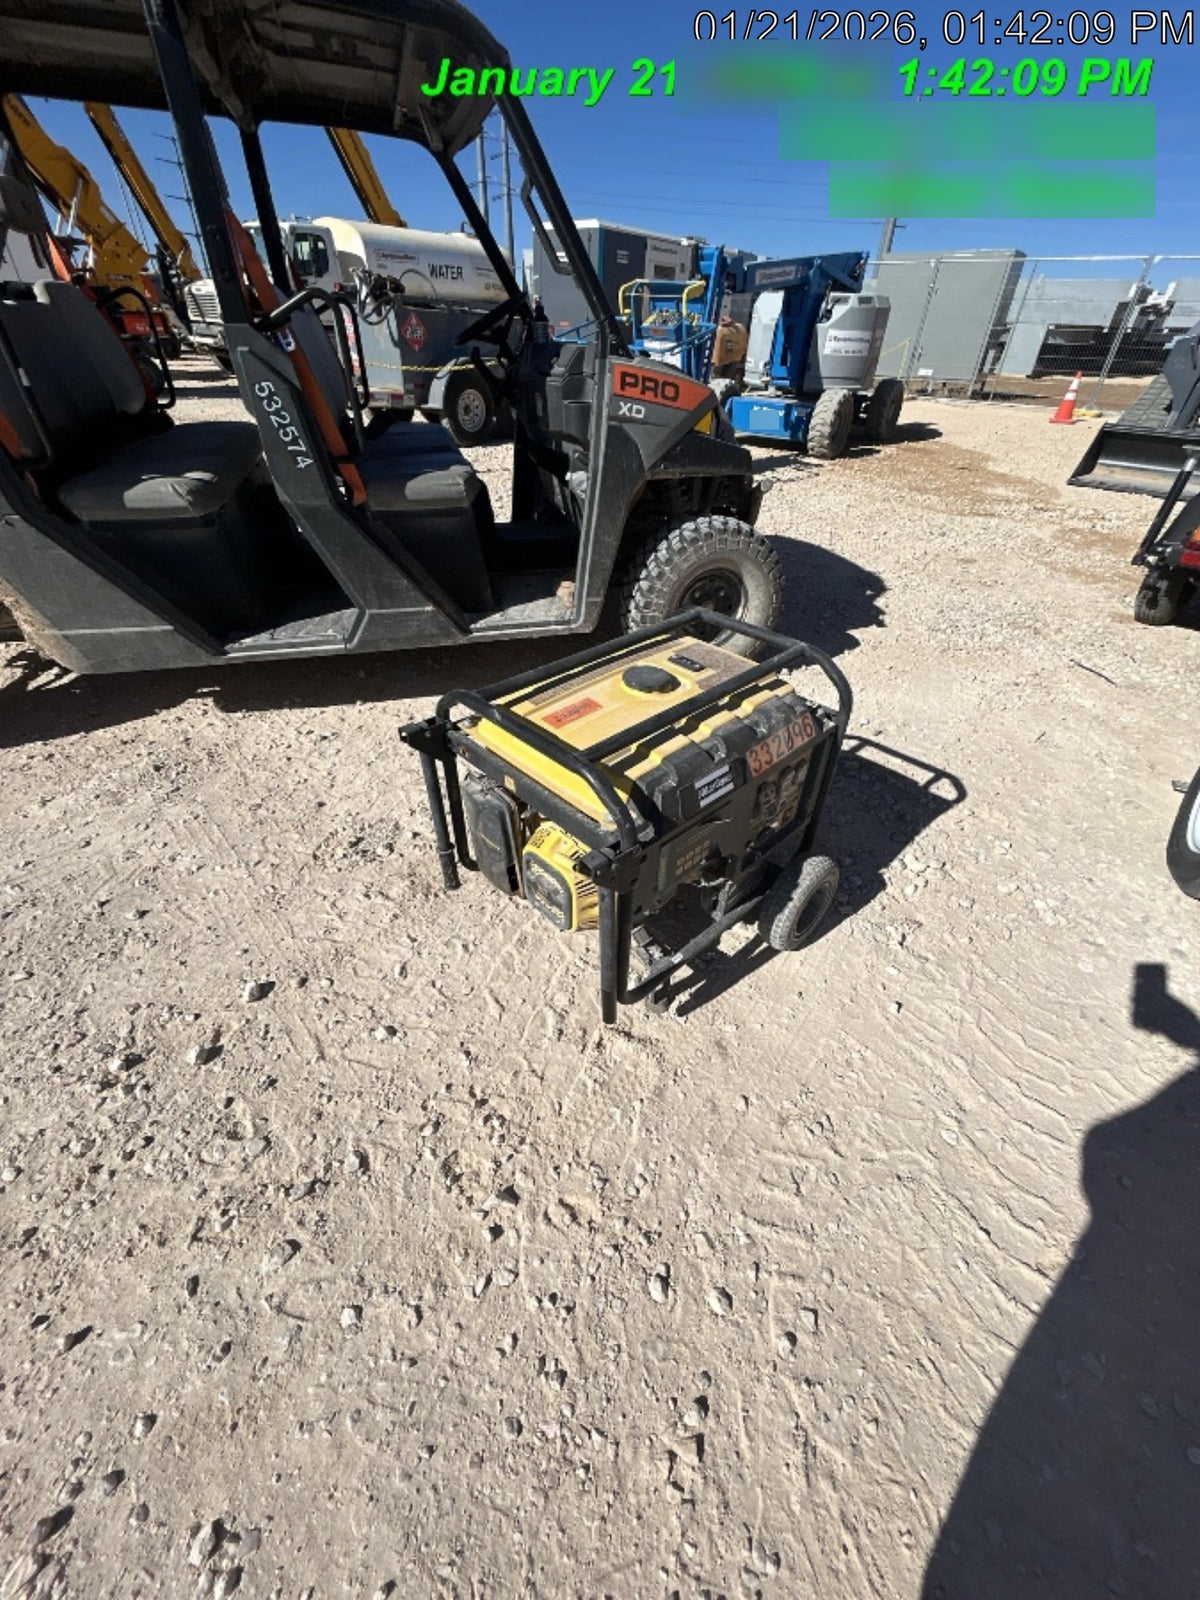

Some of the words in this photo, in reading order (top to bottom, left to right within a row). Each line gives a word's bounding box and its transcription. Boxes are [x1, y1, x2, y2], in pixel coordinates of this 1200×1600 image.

[428, 263, 464, 281] WATER
[620, 371, 680, 402] PRO
[618, 401, 646, 419] XD
[255, 381, 314, 469] 532574
